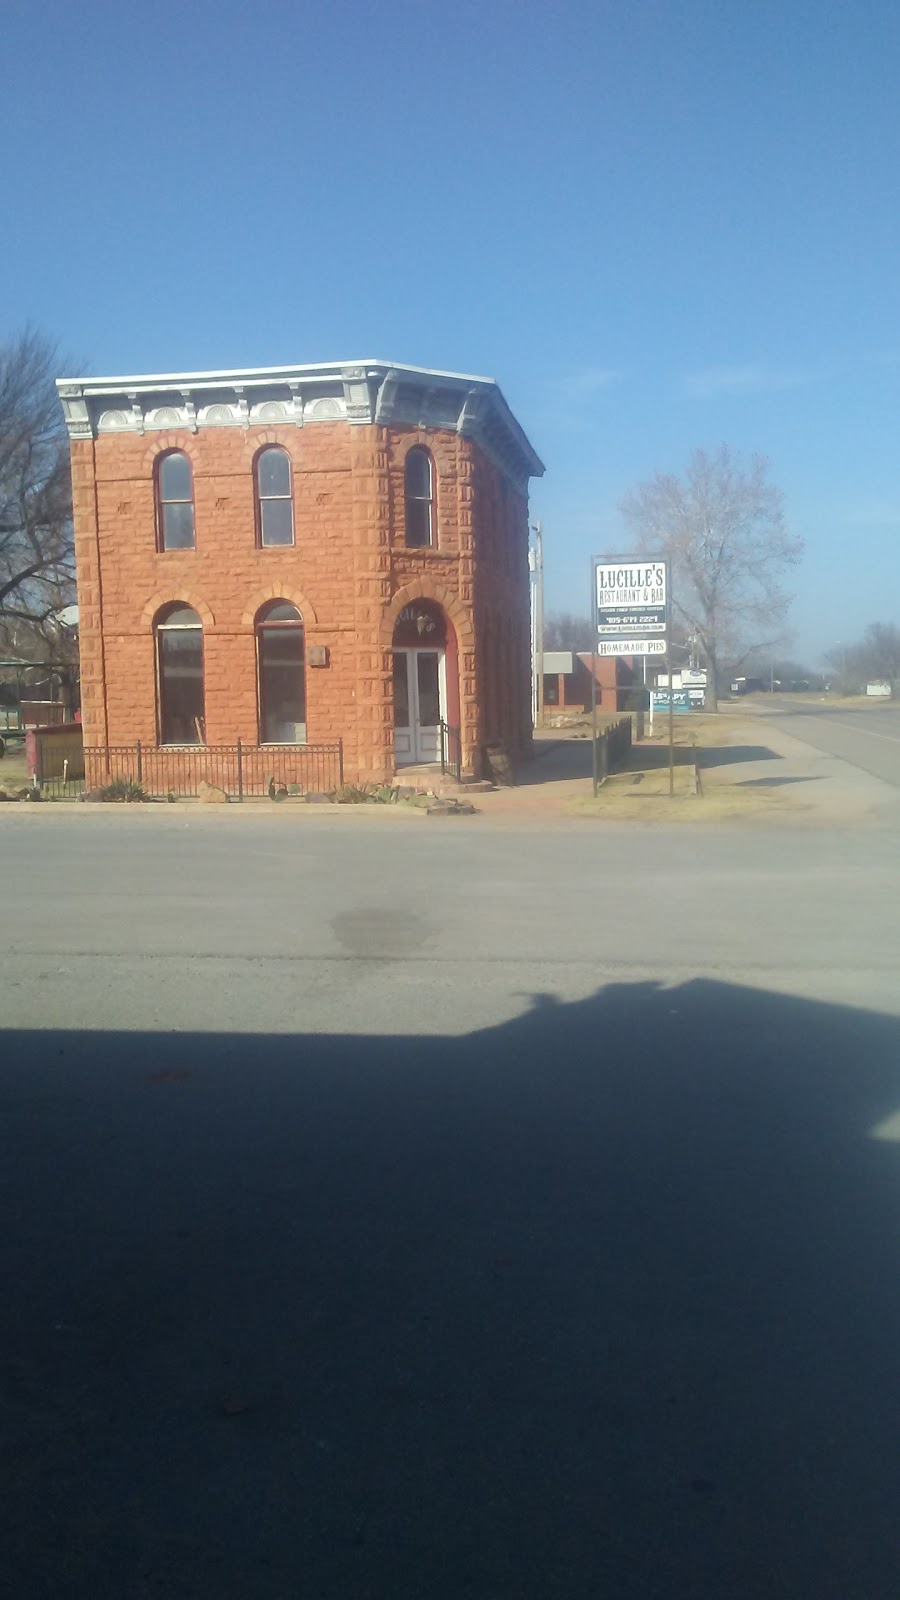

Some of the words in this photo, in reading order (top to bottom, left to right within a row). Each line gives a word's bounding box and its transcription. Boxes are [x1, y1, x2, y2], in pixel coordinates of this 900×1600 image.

[599, 564, 664, 588] LUCILLE'S
[599, 589, 641, 605] RESTAURANT
[643, 588, 649, 602] &
[651, 587, 664, 603] BAR
[600, 643, 645, 655] HOMEMADE
[647, 641, 665, 653] PIES
